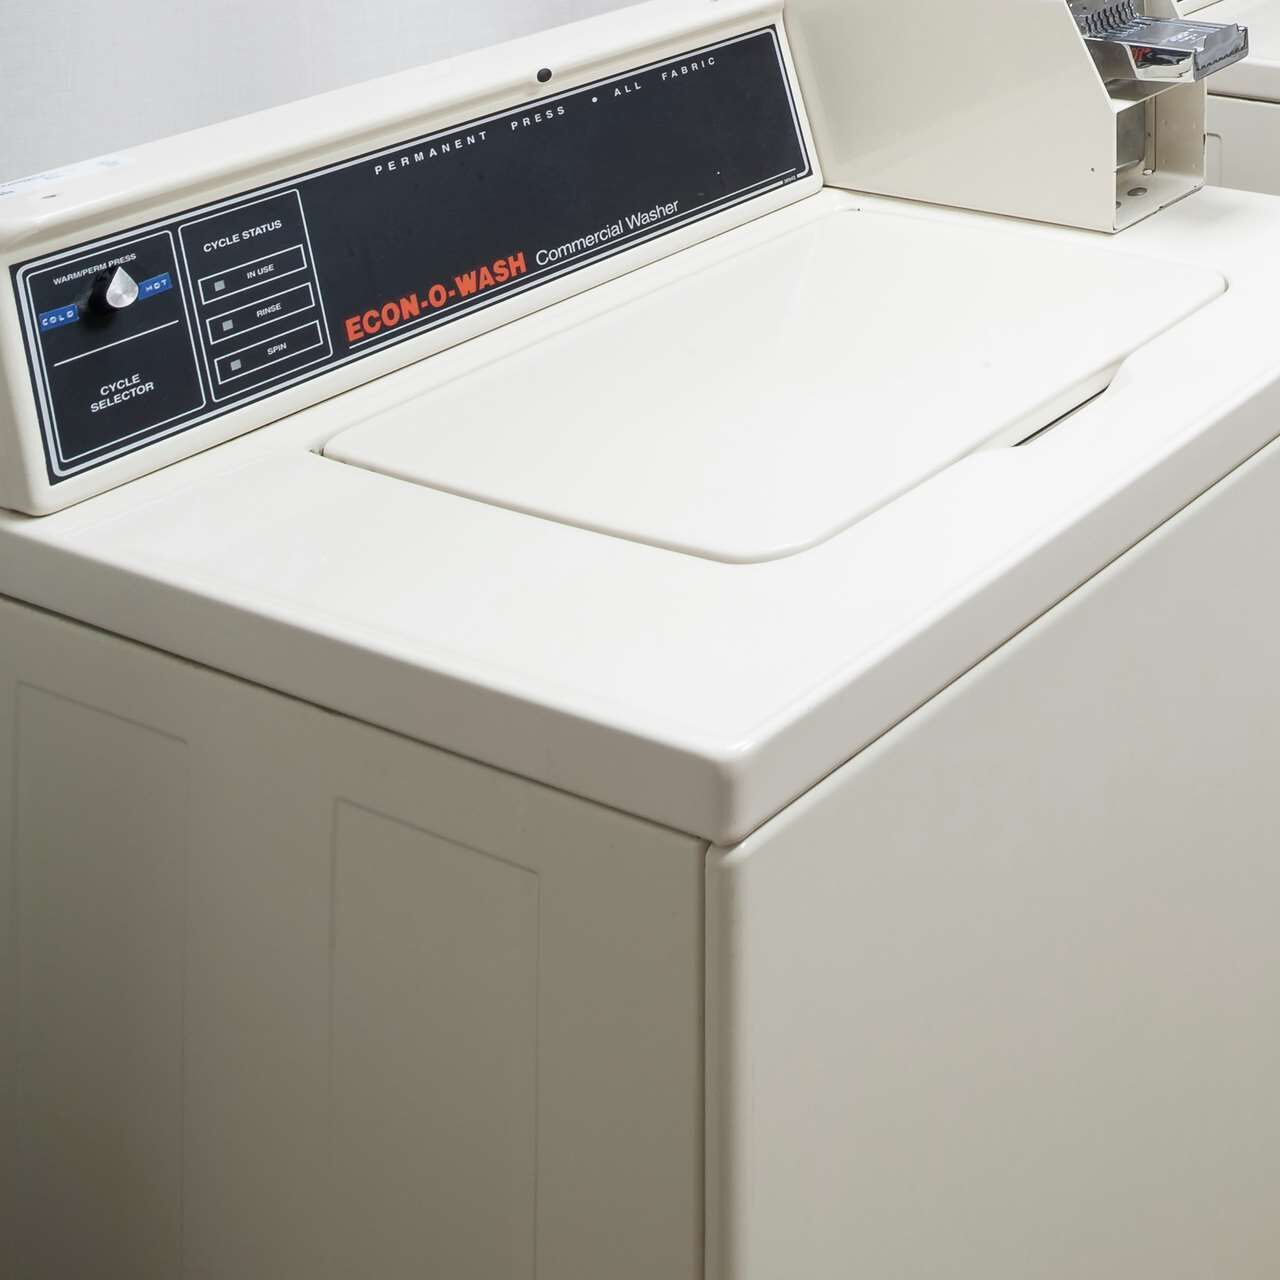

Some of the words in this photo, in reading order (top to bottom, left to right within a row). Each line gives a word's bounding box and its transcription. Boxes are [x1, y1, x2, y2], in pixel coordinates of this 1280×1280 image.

[374, 130, 487, 175] PERMANENT
[510, 106, 565, 130] PRESS
[613, 81, 642, 97] ALL
[661, 57, 716, 81] FABRIC
[203, 233, 241, 252] CYCLE
[242, 220, 282, 240] STATUS
[53, 262, 107, 285] WARM/PERM
[108, 253, 137, 268] PRESS
[246, 270, 256, 279] IN
[257, 263, 275, 276] USE
[344, 251, 527, 342] ECON-O-WASH
[535, 220, 624, 266] Commercial
[624, 199, 680, 231] Washer
[145, 278, 167, 292] HOT
[42, 310, 74, 326] COLD
[256, 303, 282, 318] RINSE
[267, 342, 287, 355] SPIN
[100, 373, 141, 395] CYCLE
[90, 381, 154, 412] SELECTOR
